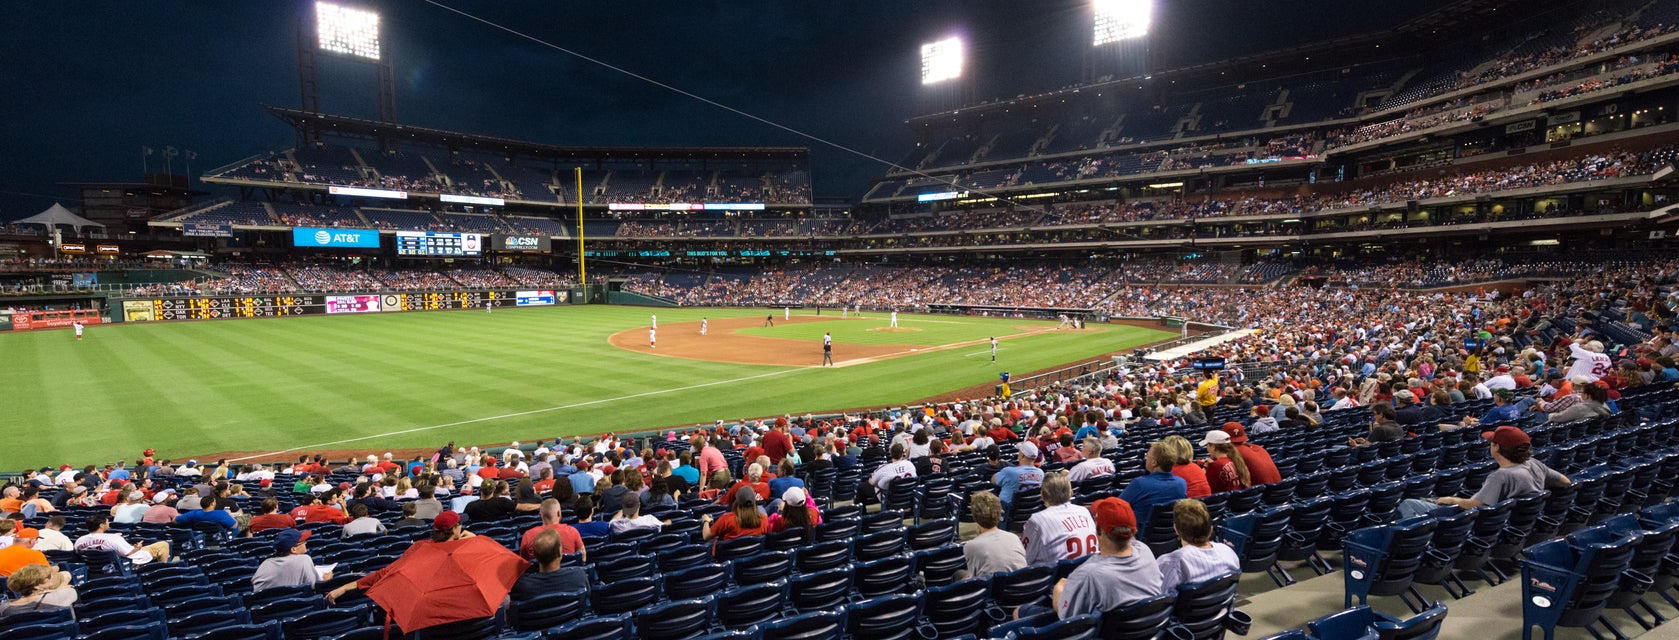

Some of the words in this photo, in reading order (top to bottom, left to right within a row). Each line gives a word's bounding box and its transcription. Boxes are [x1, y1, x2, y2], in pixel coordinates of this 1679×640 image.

[334, 234, 360, 242] AT&T
[895, 466, 905, 474] LEE
[1062, 515, 1090, 532] UTLEY
[1066, 534, 1097, 560] 26
